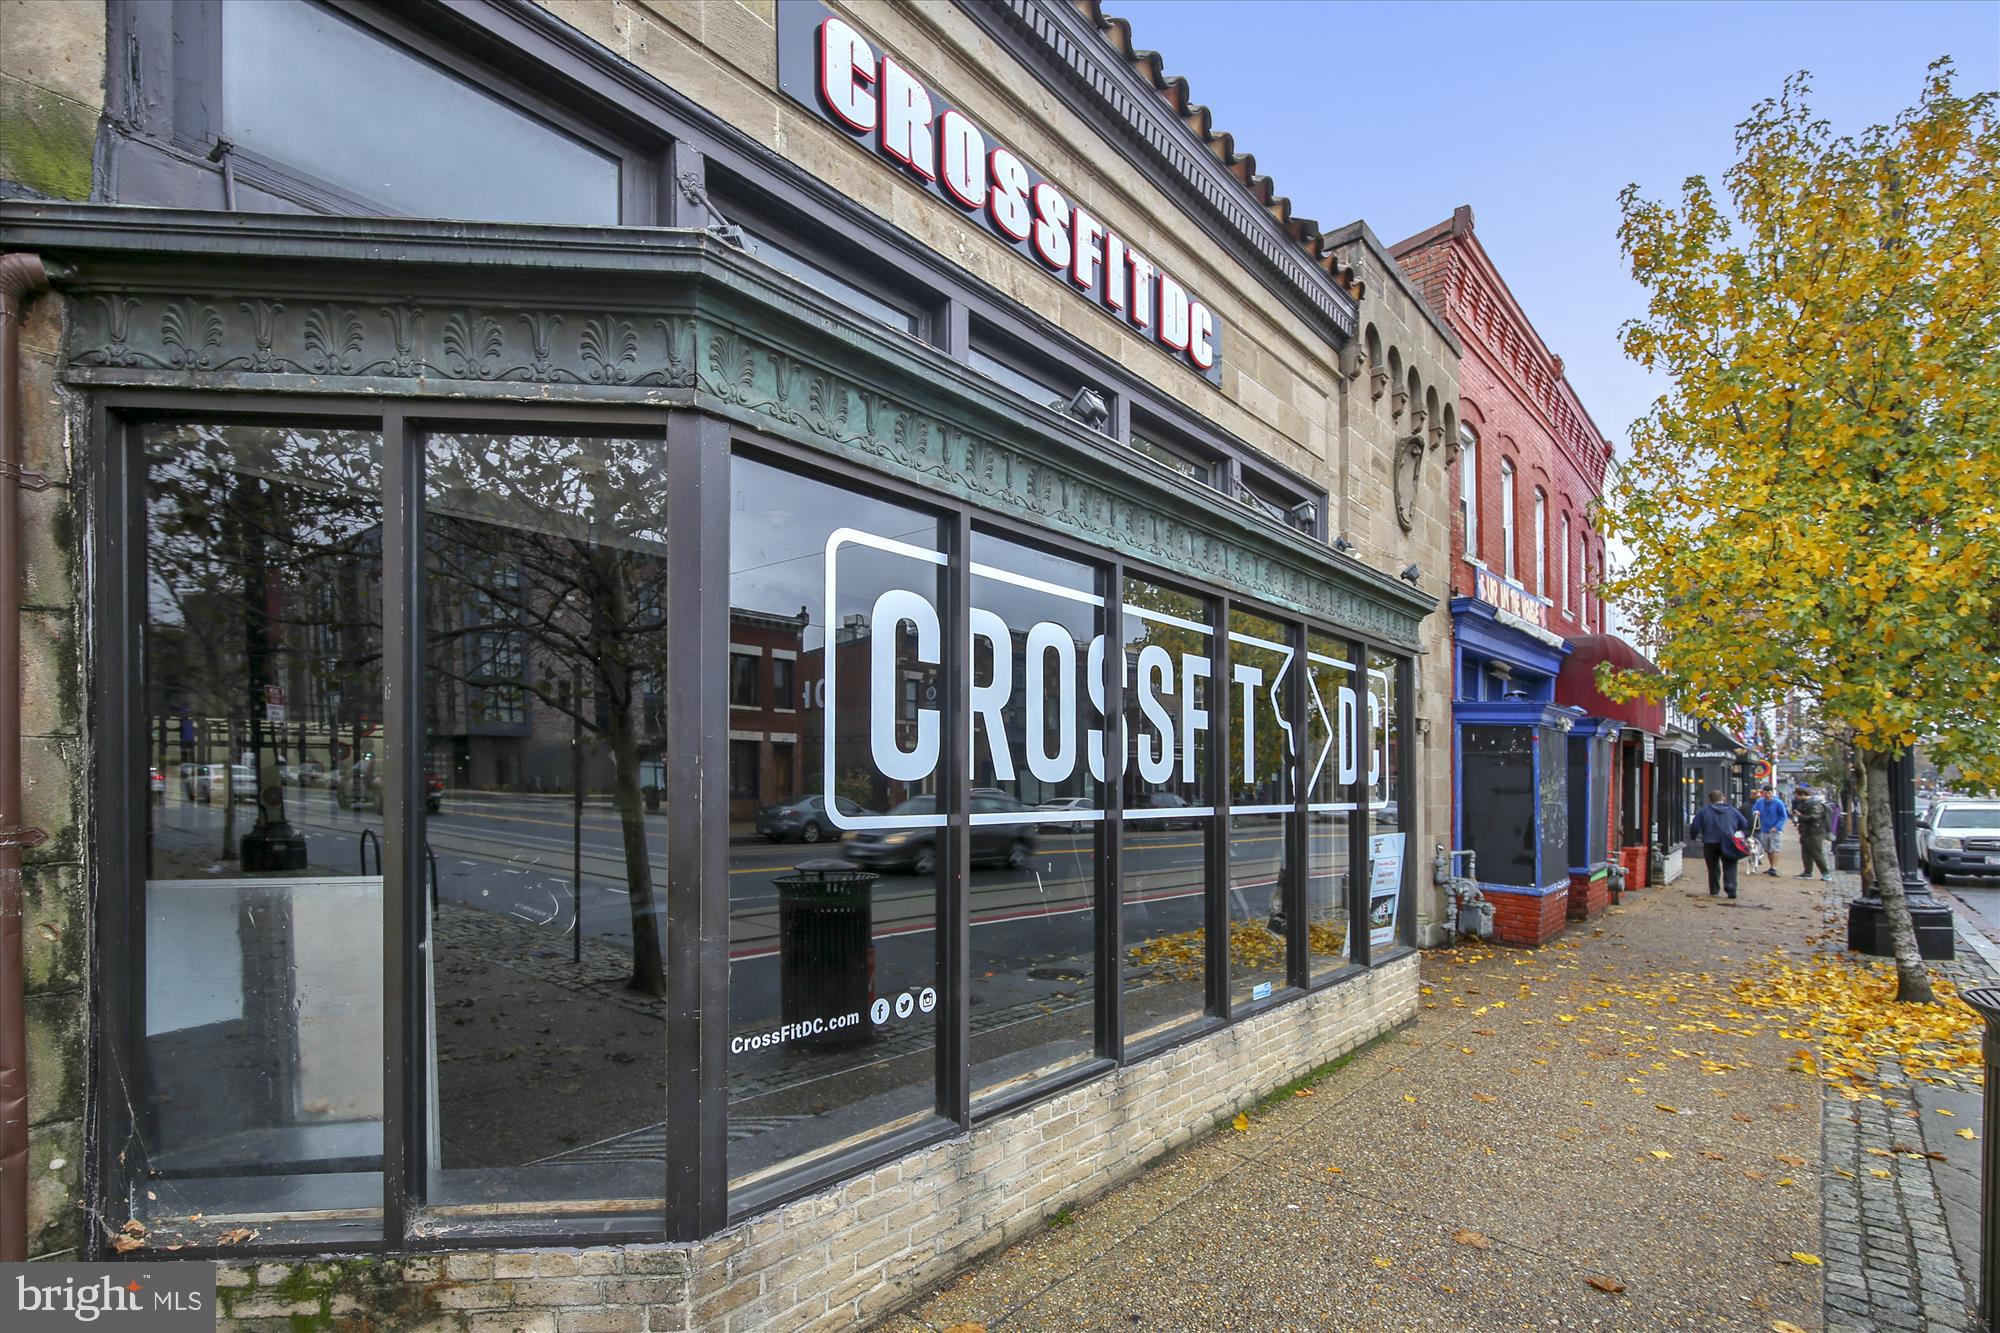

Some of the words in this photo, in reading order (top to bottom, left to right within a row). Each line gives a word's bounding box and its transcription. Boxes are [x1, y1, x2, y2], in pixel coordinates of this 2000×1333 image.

[820, 16, 1213, 370] CROSSFITDC
[870, 589, 1263, 784] CROSSFT
[731, 1012, 860, 1054] CrossFitDC.com
